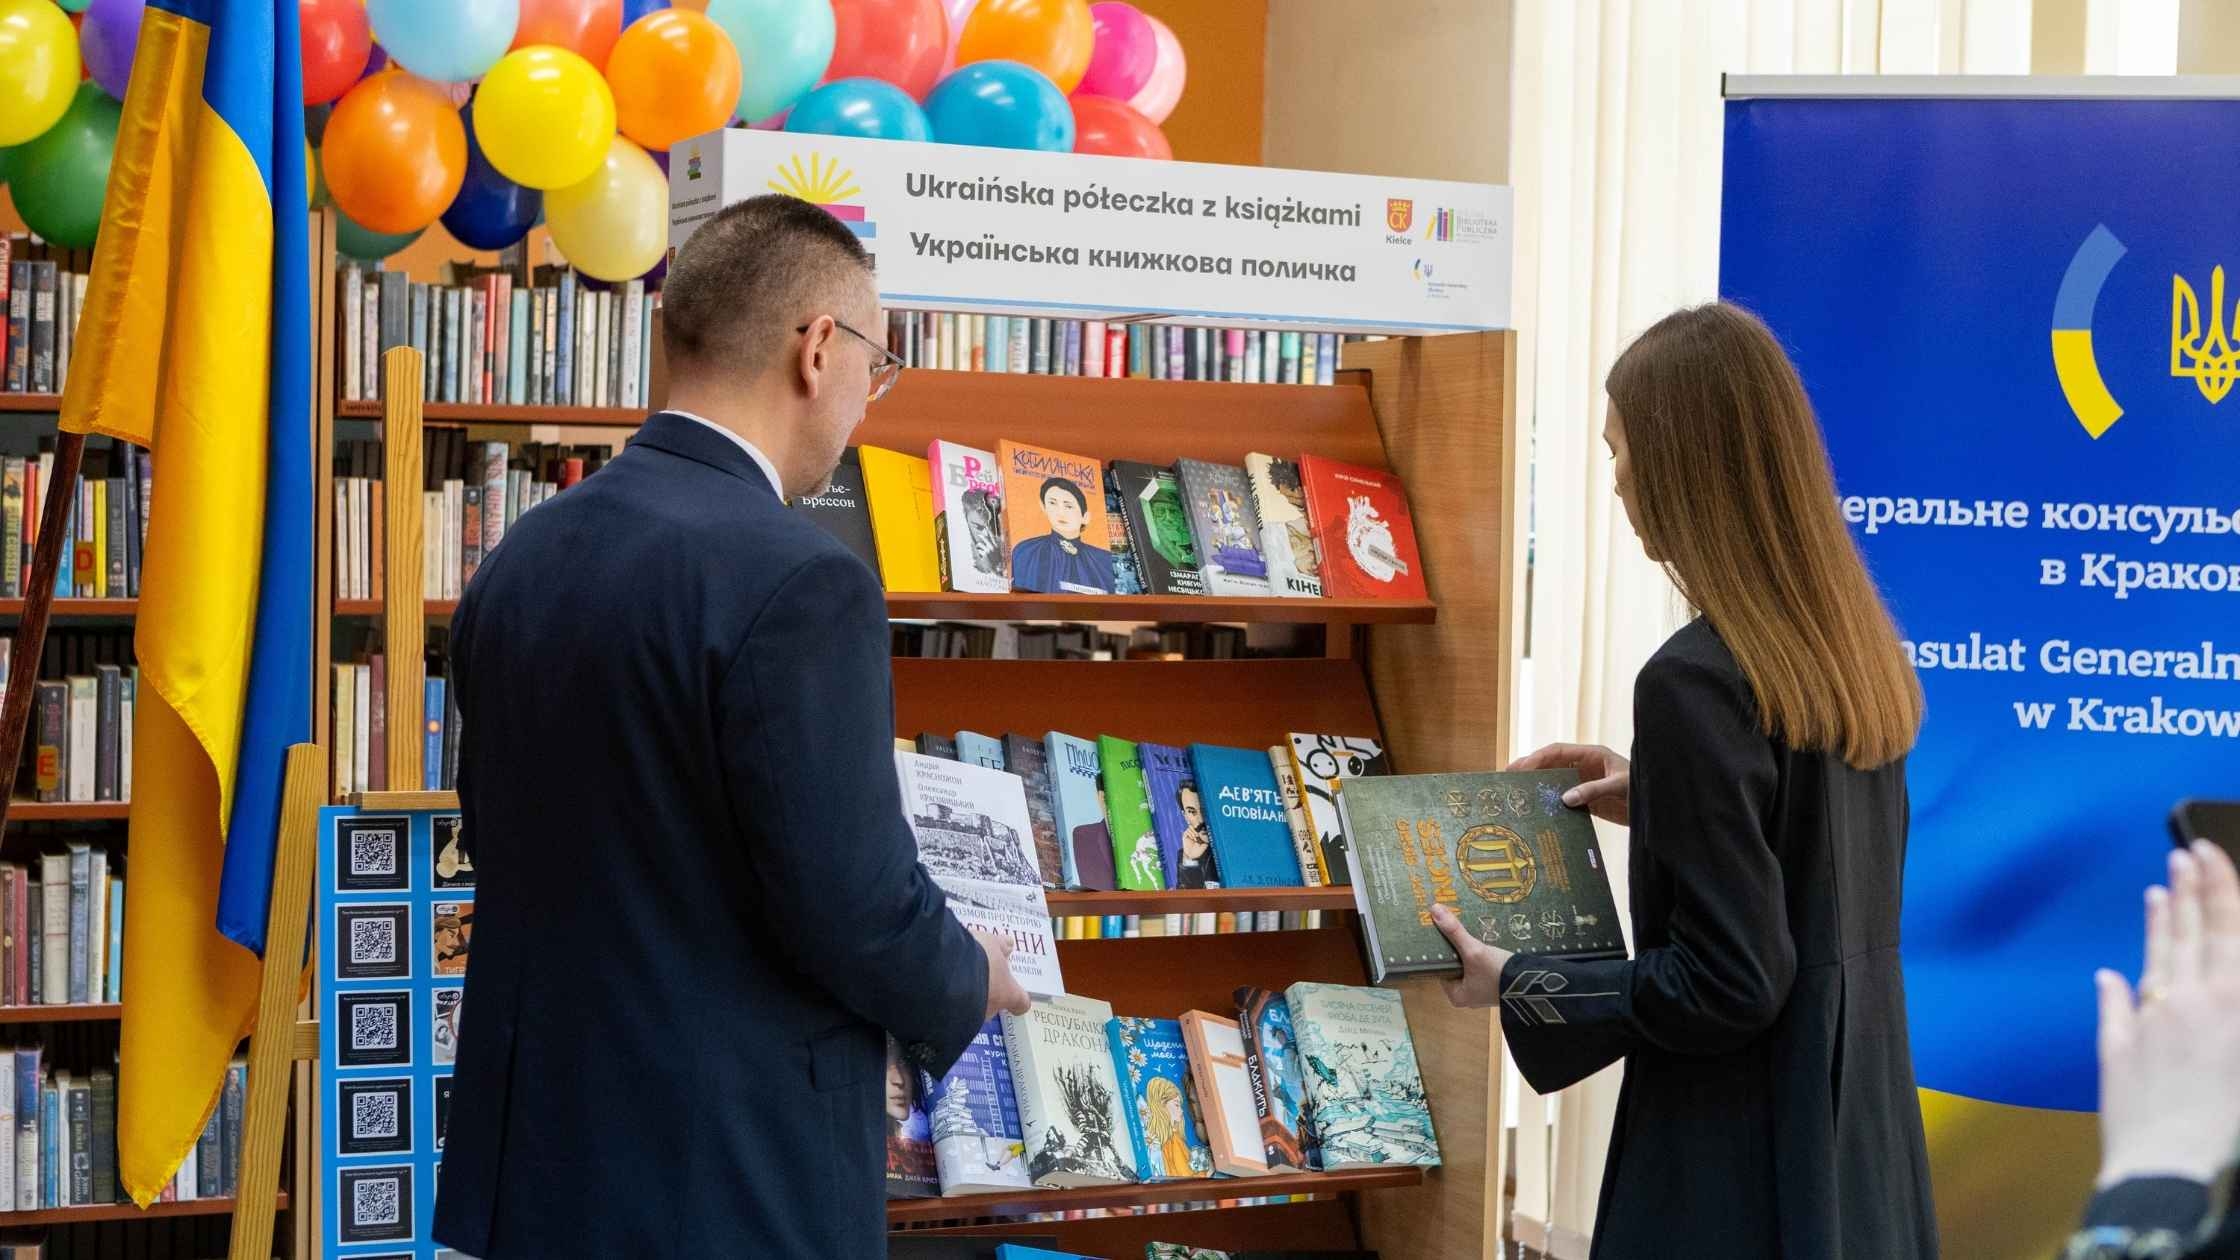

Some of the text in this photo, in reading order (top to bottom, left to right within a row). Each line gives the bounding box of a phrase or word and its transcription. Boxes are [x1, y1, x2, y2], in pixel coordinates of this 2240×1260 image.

[906, 172, 1361, 229] Ukraińska półeczka z książkami
[909, 231, 1356, 282] Українська книжкова поличка
[1385, 235, 1412, 246] Kielce
[2041, 559, 2066, 585] в
[2014, 701, 2055, 729] w
[1247, 1054, 1269, 1118] БЛАКИТЬ
